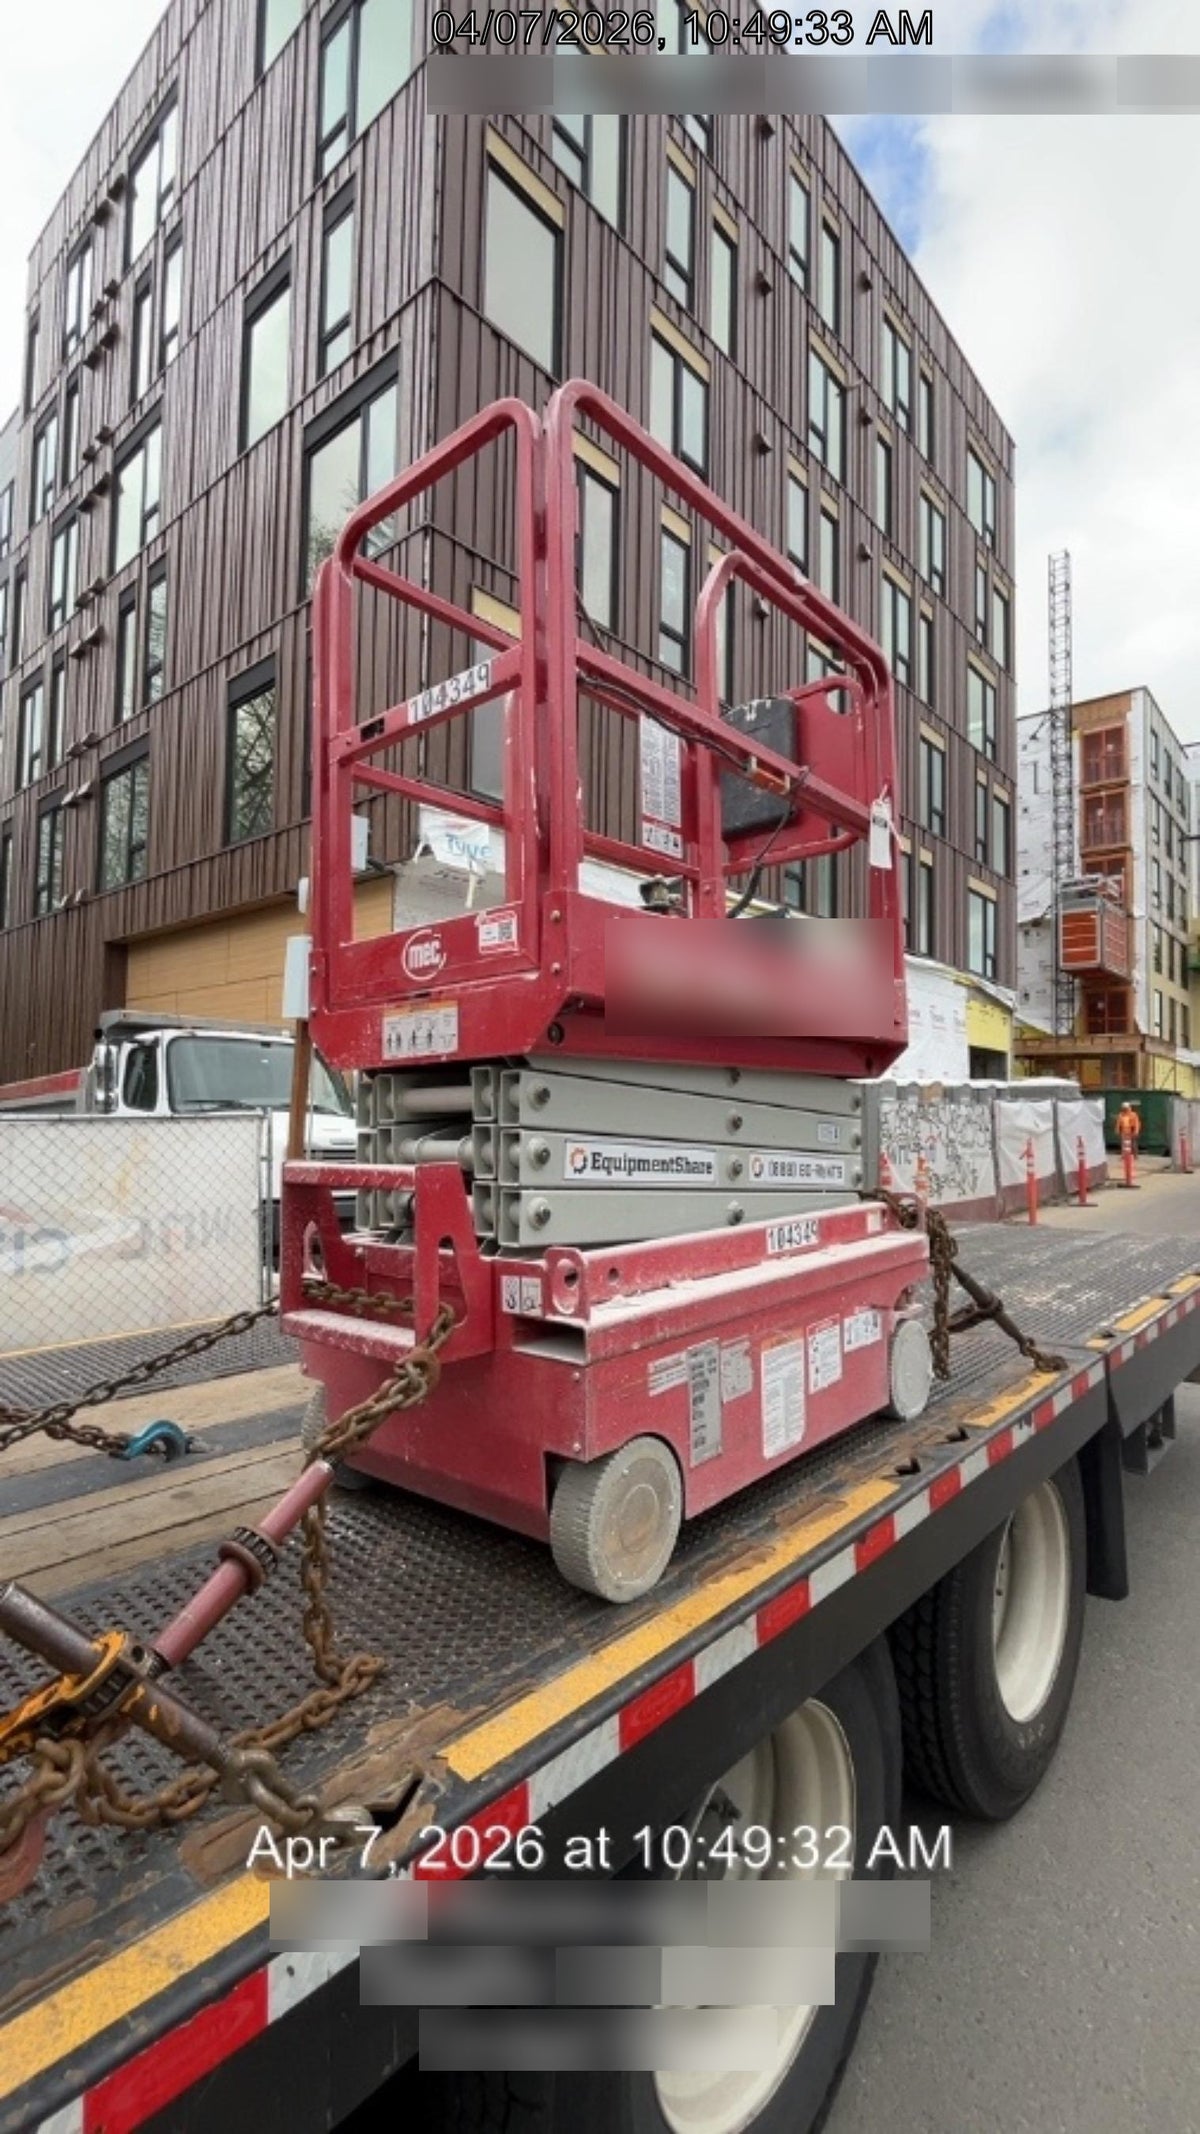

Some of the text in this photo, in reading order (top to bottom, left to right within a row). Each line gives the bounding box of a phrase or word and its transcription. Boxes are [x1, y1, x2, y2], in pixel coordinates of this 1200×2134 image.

[411, 663, 490, 722] 104349
[590, 1152, 713, 1176] EquipmentShare
[768, 1220, 817, 1250] 104349
